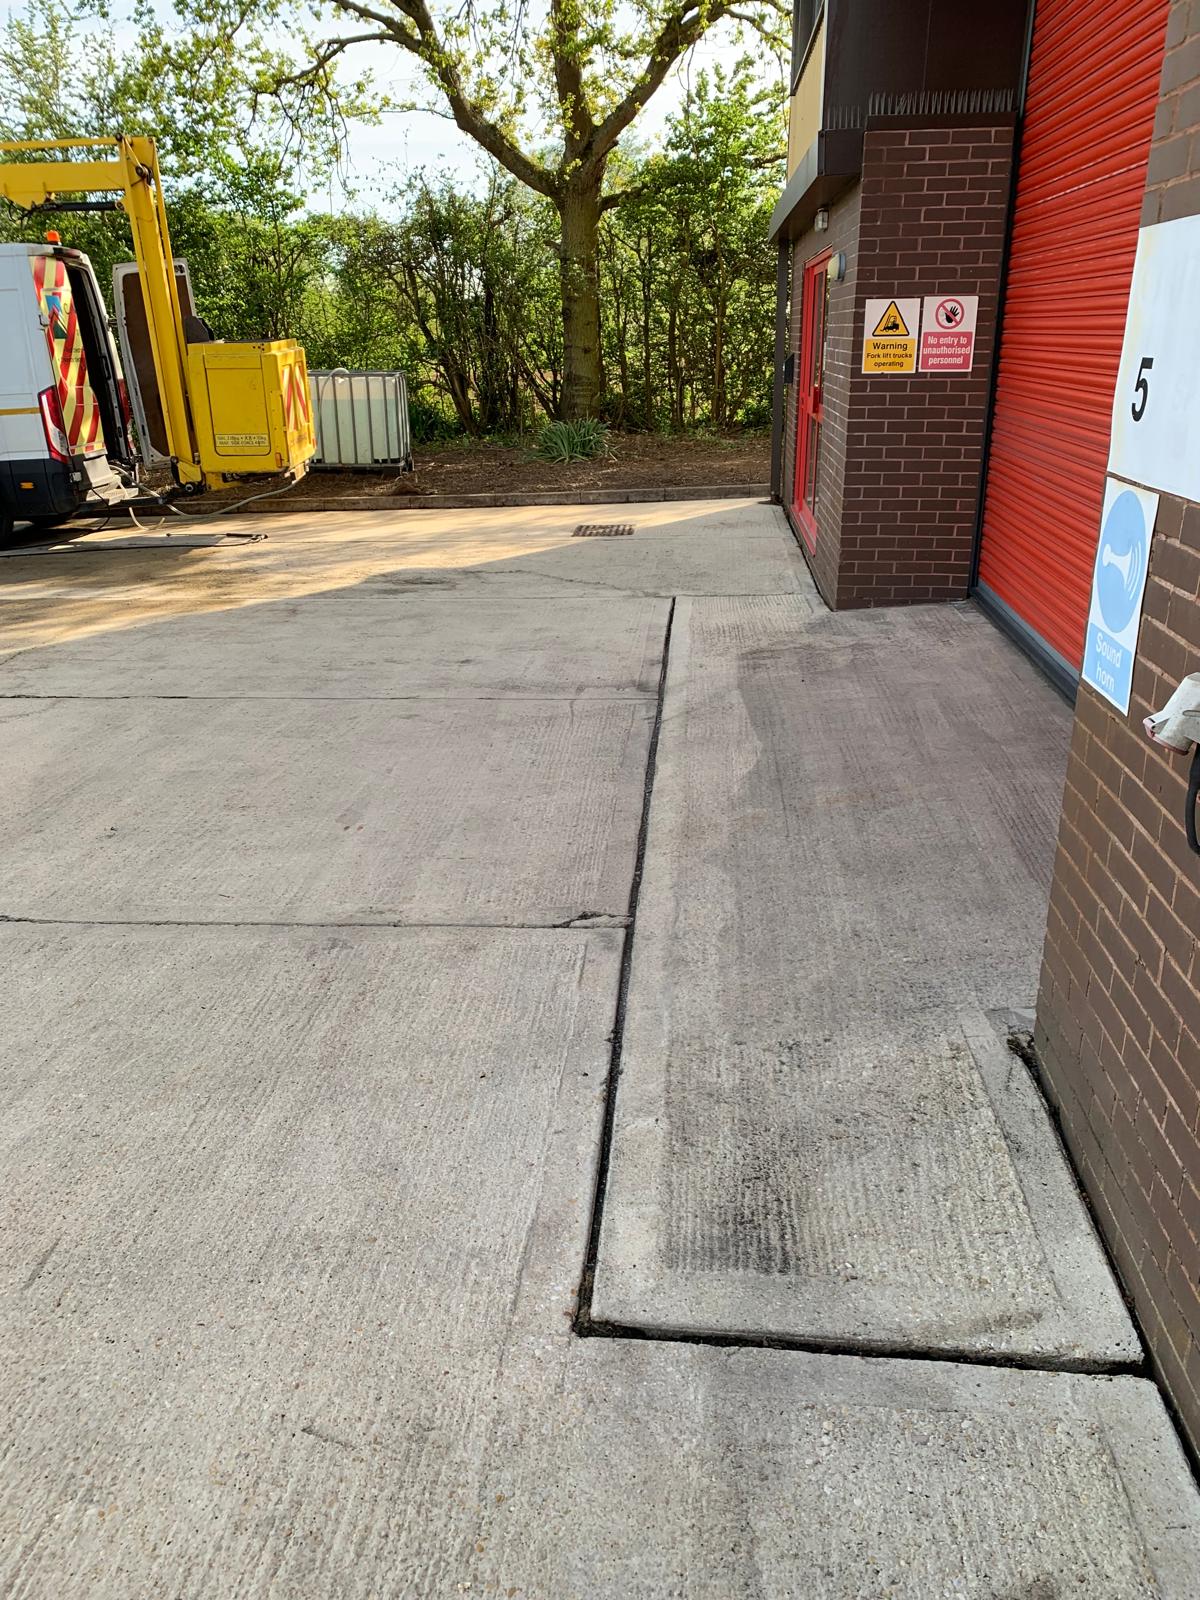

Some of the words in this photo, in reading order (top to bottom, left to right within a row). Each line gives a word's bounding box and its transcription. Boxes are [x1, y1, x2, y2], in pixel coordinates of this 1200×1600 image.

[928, 336, 938, 344] No
[940, 336, 957, 346] entry
[960, 336, 967, 344] to
[872, 342, 908, 351] Warning
[923, 345, 971, 354] unauthorised
[928, 356, 963, 365] personnel
[1131, 357, 1154, 422] 5
[1095, 632, 1123, 669] Sound
[1095, 664, 1115, 693] horn
